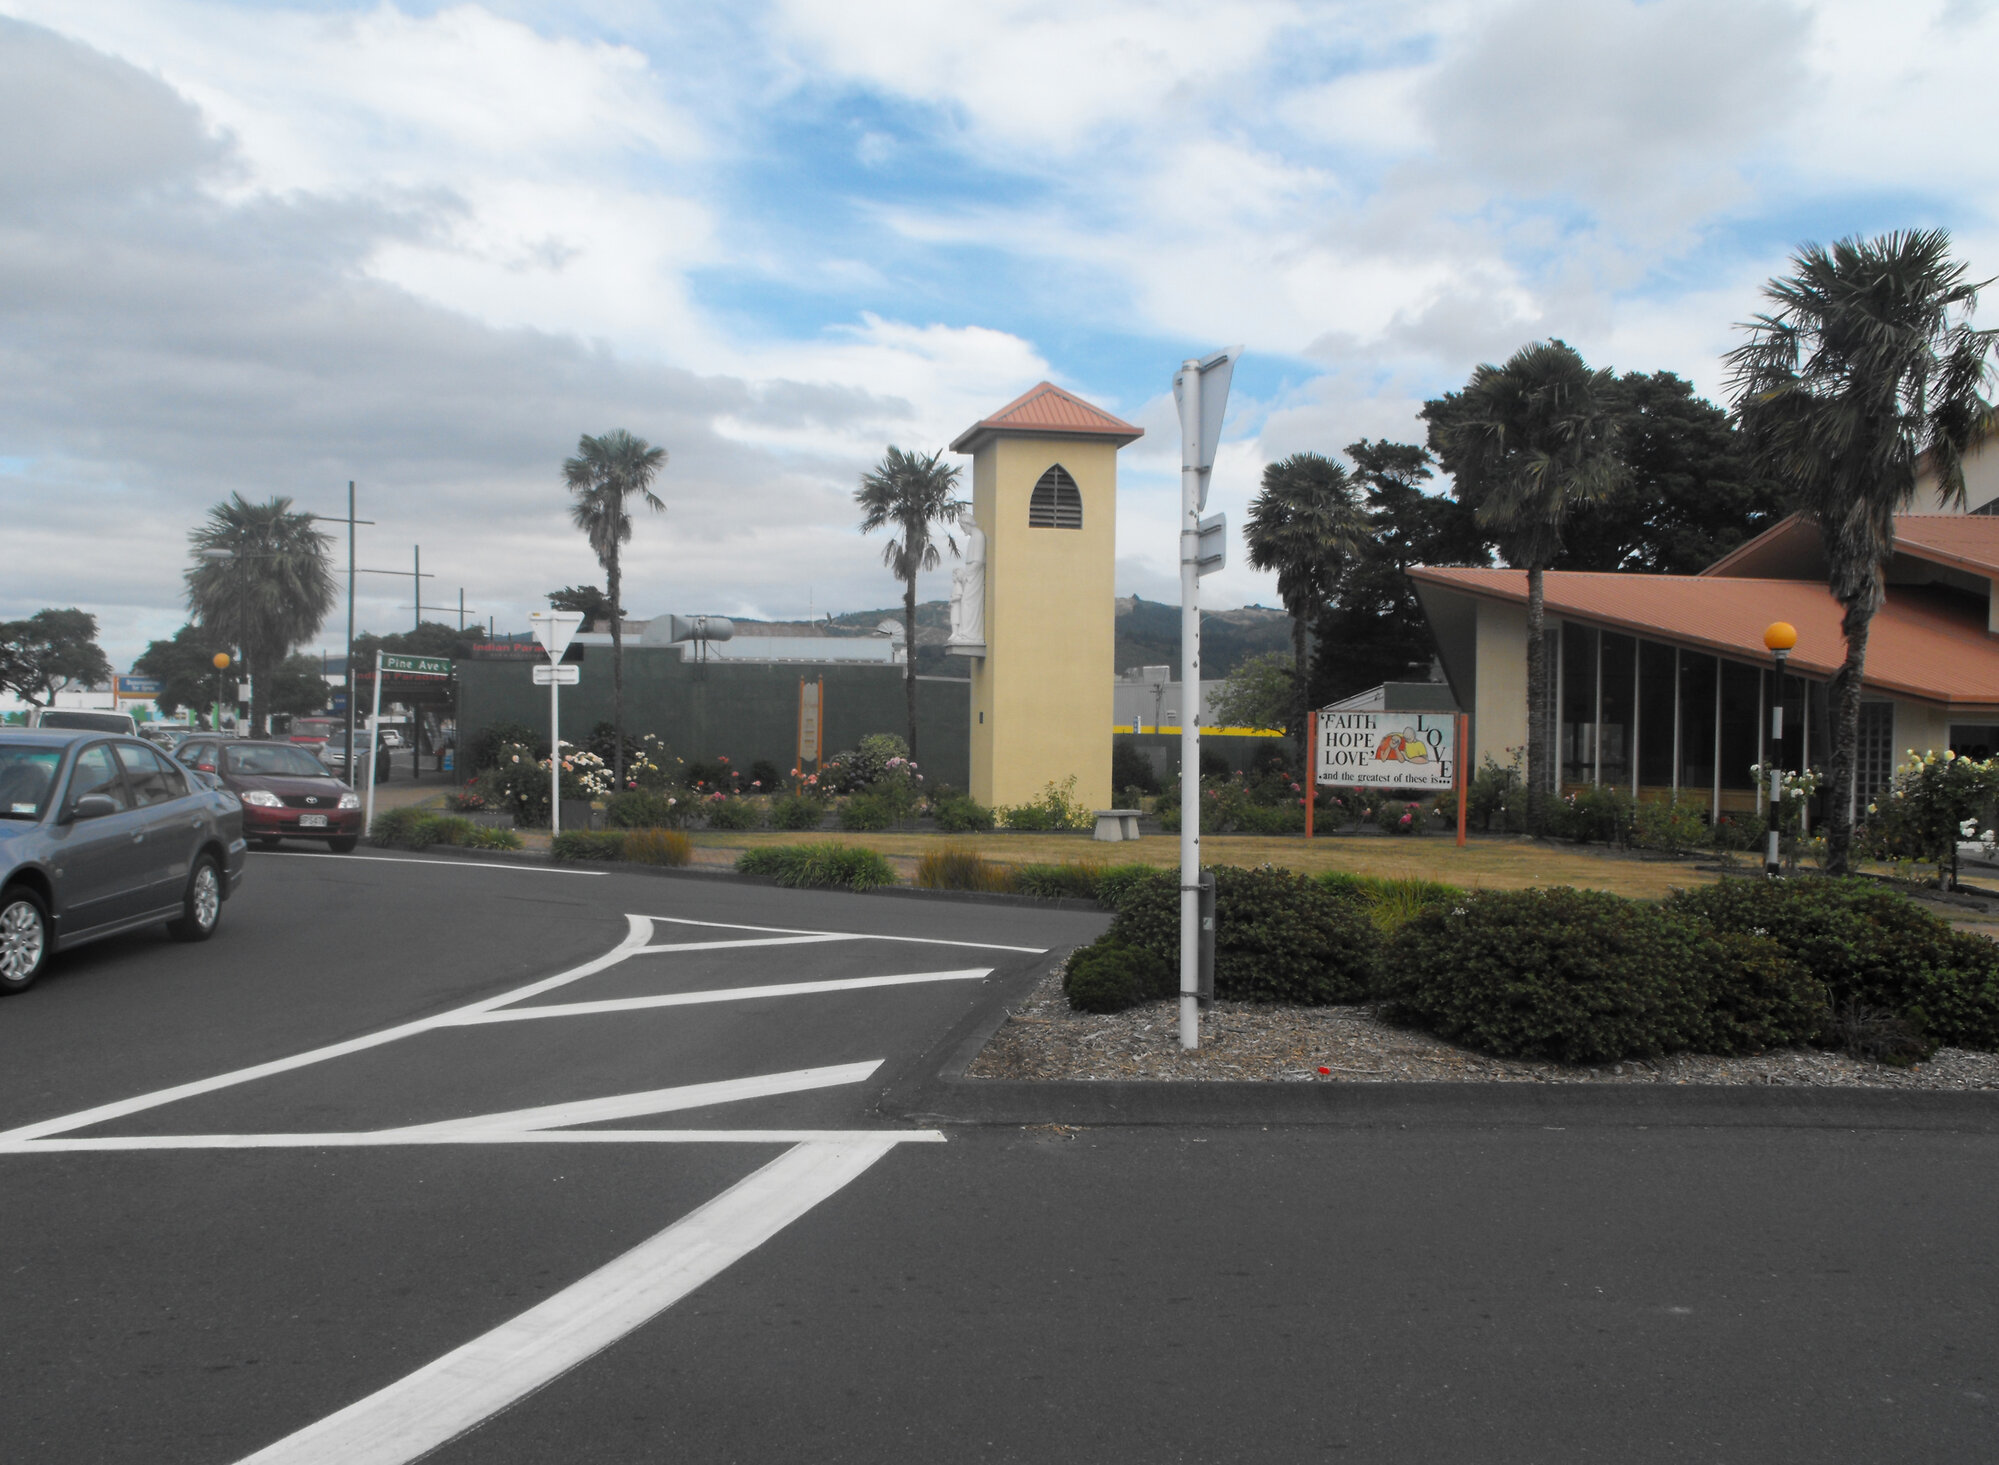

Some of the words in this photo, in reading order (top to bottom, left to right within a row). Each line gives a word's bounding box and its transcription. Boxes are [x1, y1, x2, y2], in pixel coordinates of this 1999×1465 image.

[473, 643, 510, 652] Indian
[514, 643, 545, 653] Para
[387, 657, 412, 669] Pine
[418, 660, 440, 671] Ave
[1325, 732, 1375, 748] HOPE
[1341, 771, 1355, 781] the
[1357, 773, 1391, 783] greatest
[1393, 773, 1403, 783] of
[1405, 773, 1428, 784] these
